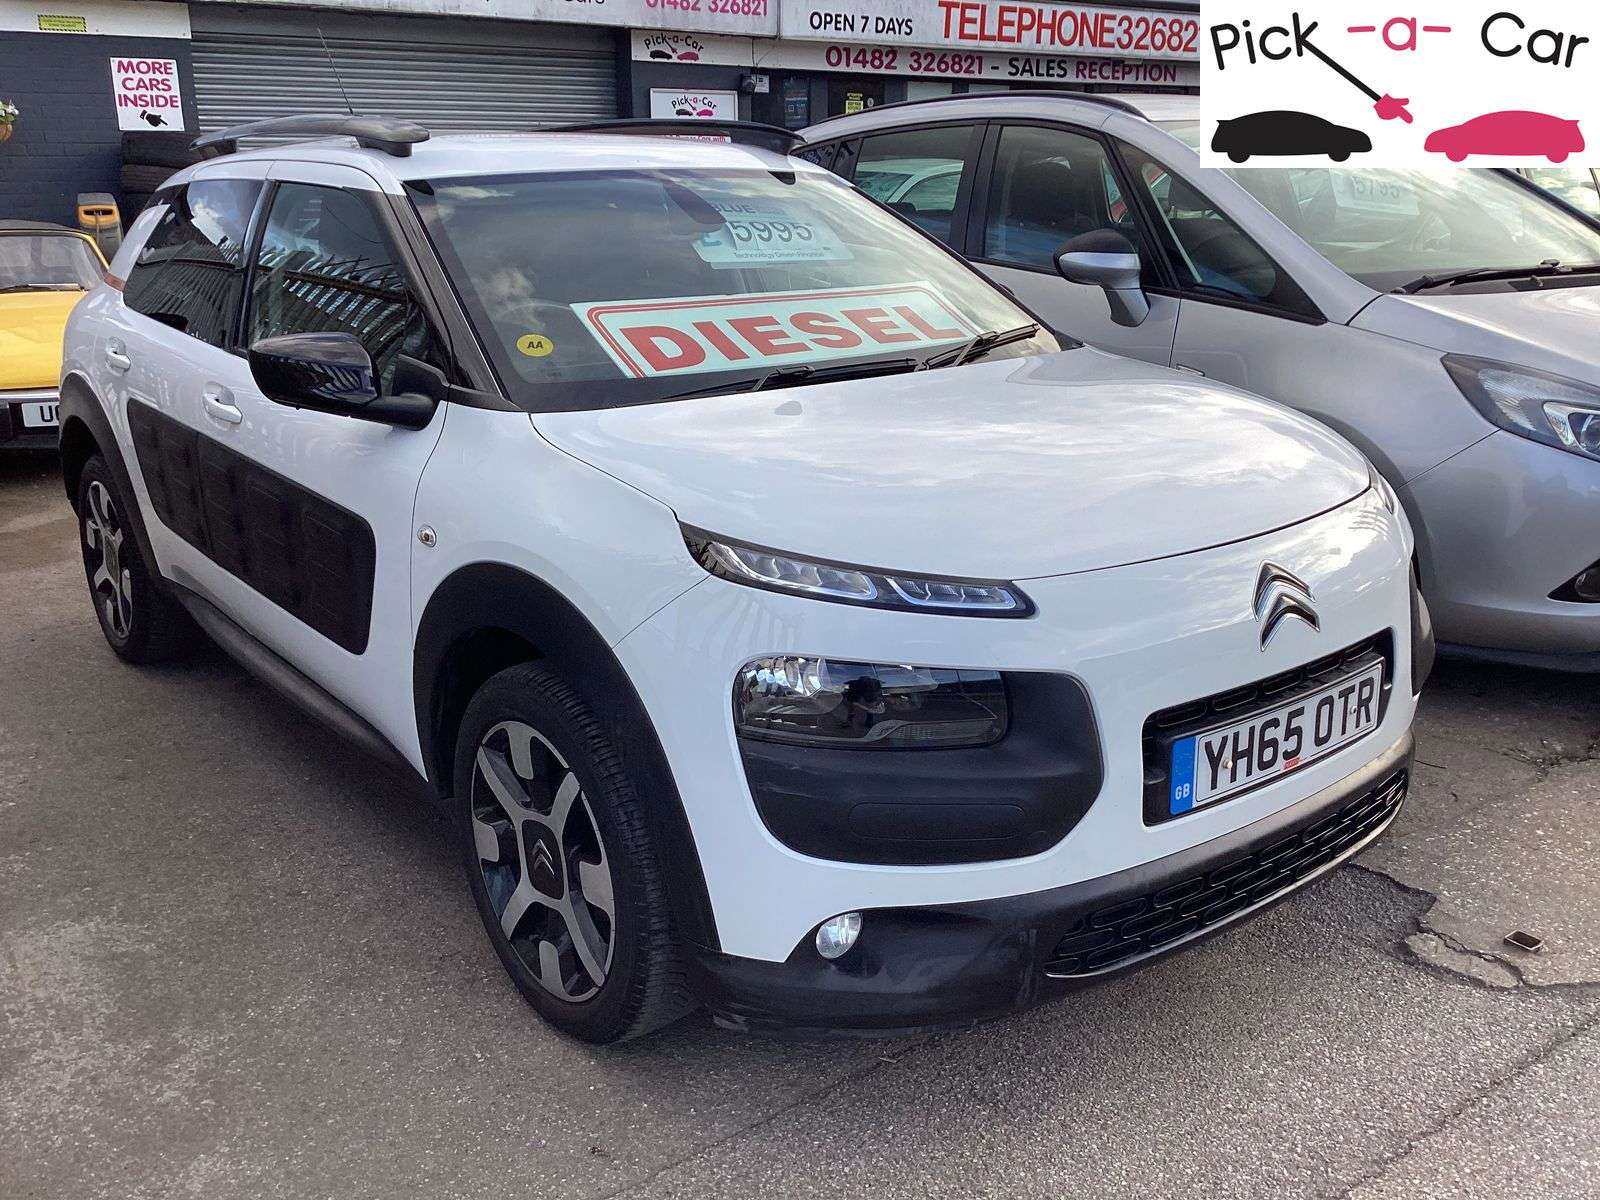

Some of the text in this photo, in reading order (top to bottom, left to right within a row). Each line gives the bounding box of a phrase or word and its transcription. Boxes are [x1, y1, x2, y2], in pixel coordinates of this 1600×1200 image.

[708, 0, 768, 16] 326821
[809, 11, 913, 36] OPEN 7 DAYS
[938, 0, 1200, 53] TELEPHONE32682
[116, 60, 174, 75] MORE
[825, 46, 899, 70] 01482
[909, 51, 983, 75] 326821
[1007, 57, 1068, 79] SALES
[1075, 61, 1177, 82] RECEPTION
[121, 77, 173, 92] CARS
[117, 94, 179, 108] INSIDE
[527, 341, 544, 349] AA
[620, 305, 970, 372] DIESEL
[1204, 676, 1375, 791] YH65 OTR
[1175, 781, 1191, 801] GB
